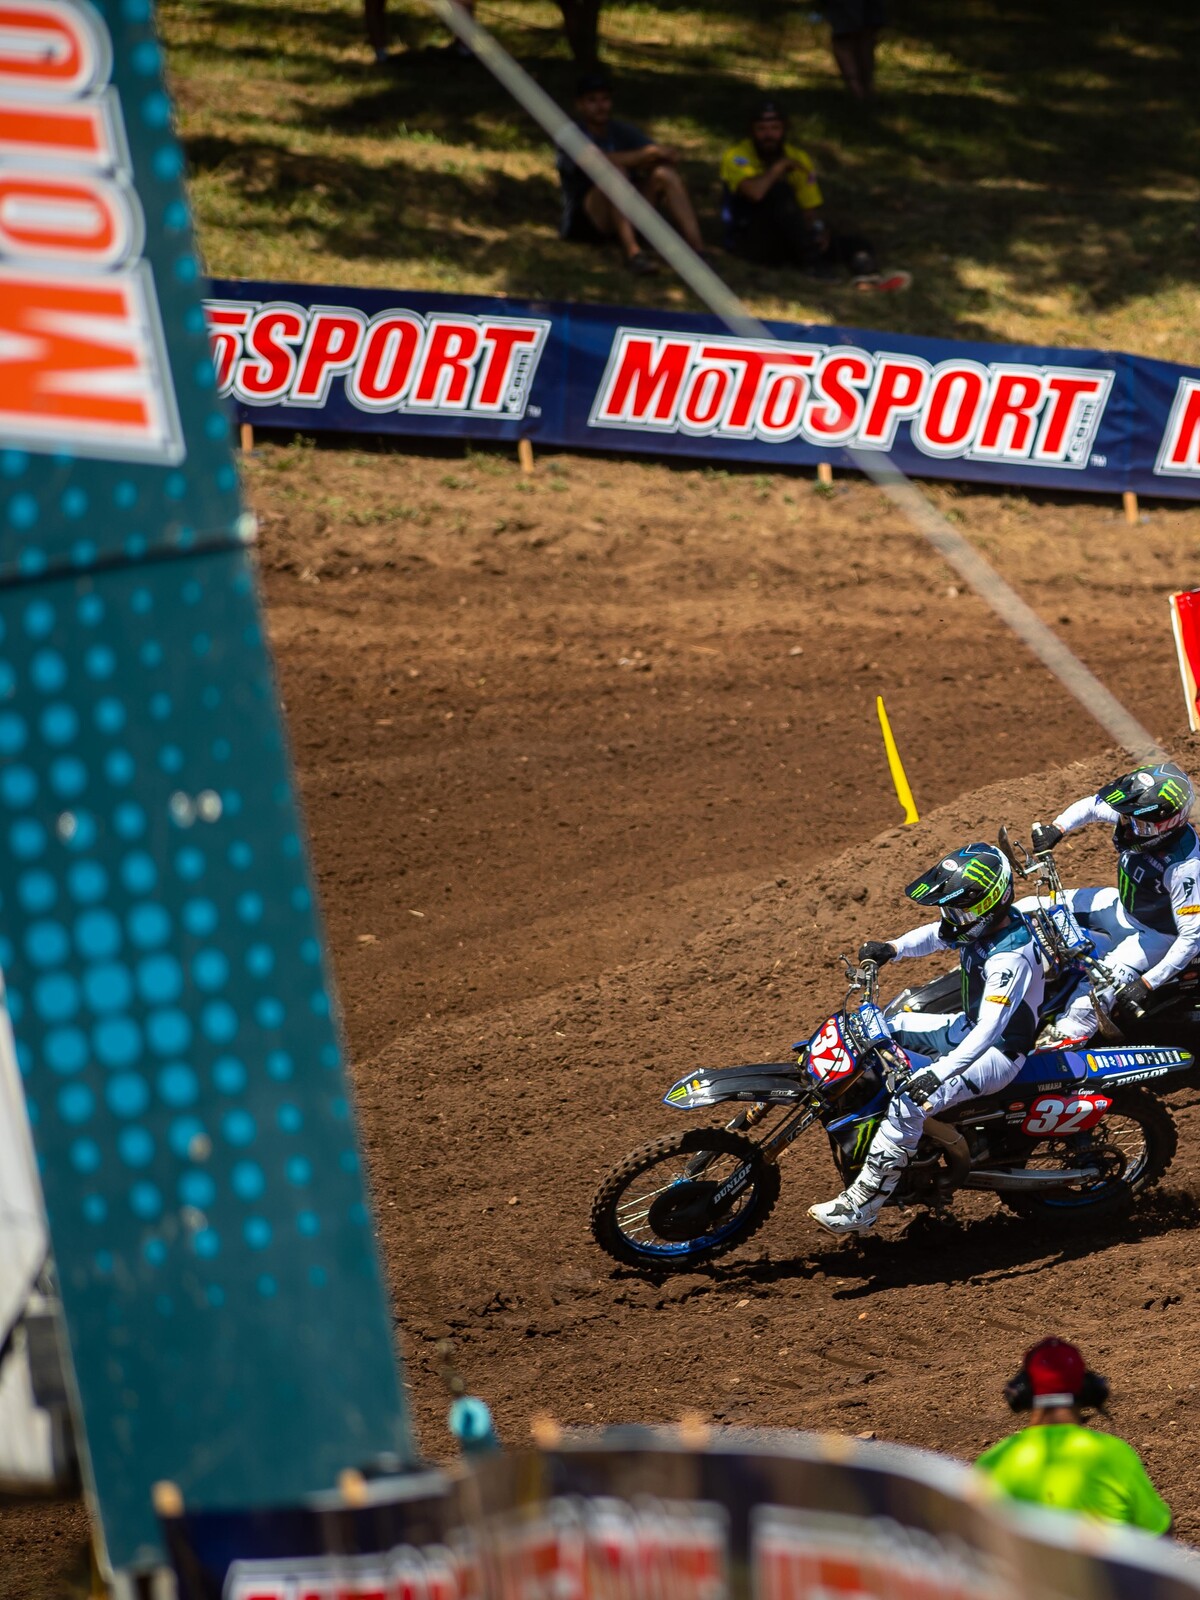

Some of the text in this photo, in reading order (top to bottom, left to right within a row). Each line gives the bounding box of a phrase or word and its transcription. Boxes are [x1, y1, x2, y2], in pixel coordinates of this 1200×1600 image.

[811, 1023, 853, 1081] 32
[1037, 1081, 1063, 1093] YAMAHA
[1116, 1067, 1169, 1088] DUNLOP
[1026, 1098, 1094, 1134] 32
[713, 1162, 753, 1205] DUNLOP
